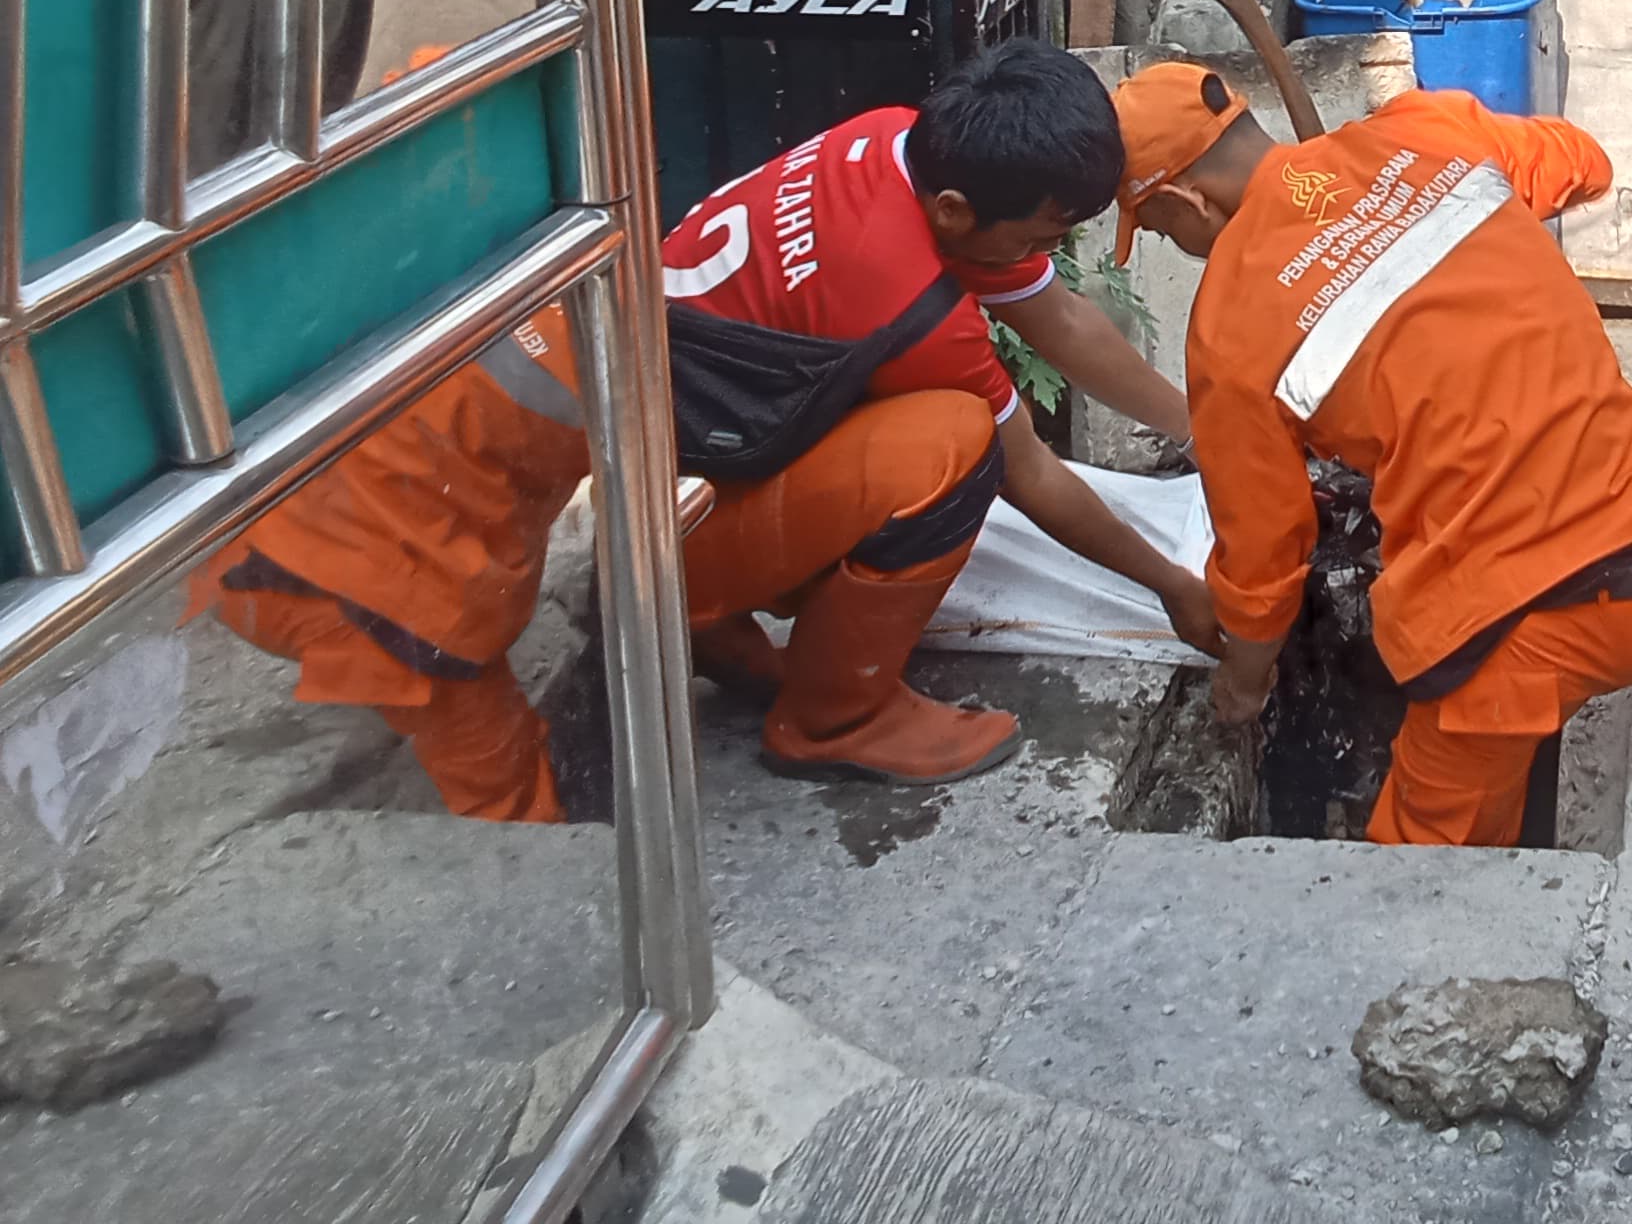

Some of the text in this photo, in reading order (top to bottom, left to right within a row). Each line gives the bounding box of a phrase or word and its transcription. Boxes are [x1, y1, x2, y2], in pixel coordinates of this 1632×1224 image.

[773, 173, 819, 292] ZAHRA
[1320, 180, 1417, 271] & SARANA UMUM
[1351, 148, 1420, 221] PRASARANA
[1295, 253, 1370, 333] KELURAHAN
[1359, 224, 1405, 259] RAWA
